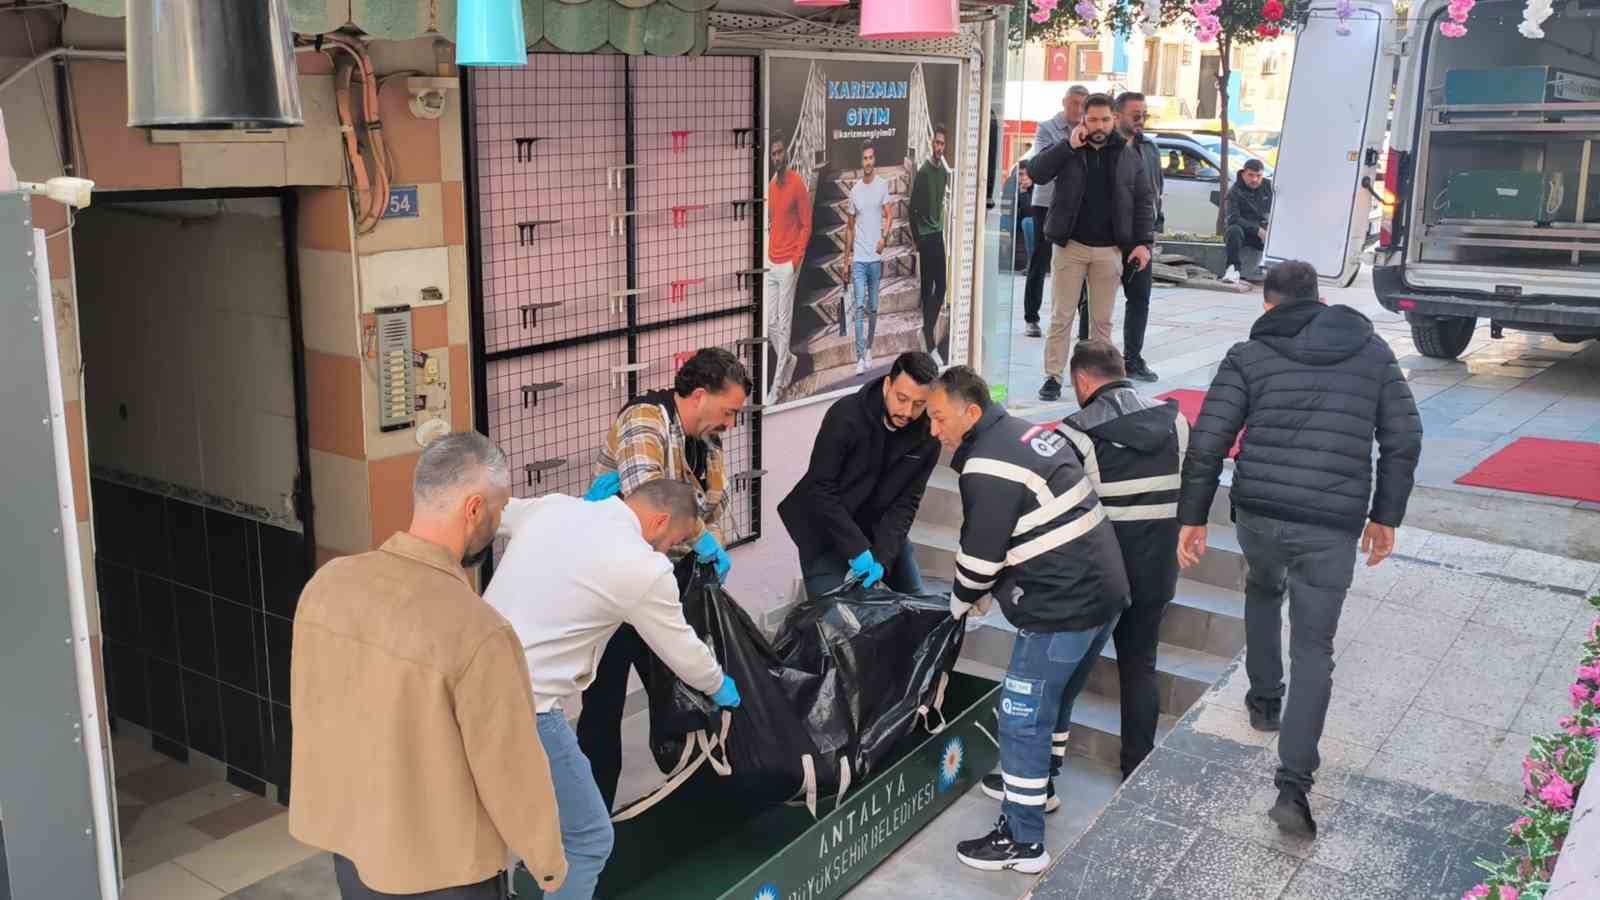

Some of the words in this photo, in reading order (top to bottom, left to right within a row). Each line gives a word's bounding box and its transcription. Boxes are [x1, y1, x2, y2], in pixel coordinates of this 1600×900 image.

[827, 80, 907, 99] KARİZMAN
[847, 107, 890, 126] GİYİM
[390, 194, 410, 212] 54
[819, 773, 905, 858] ANTALYA
